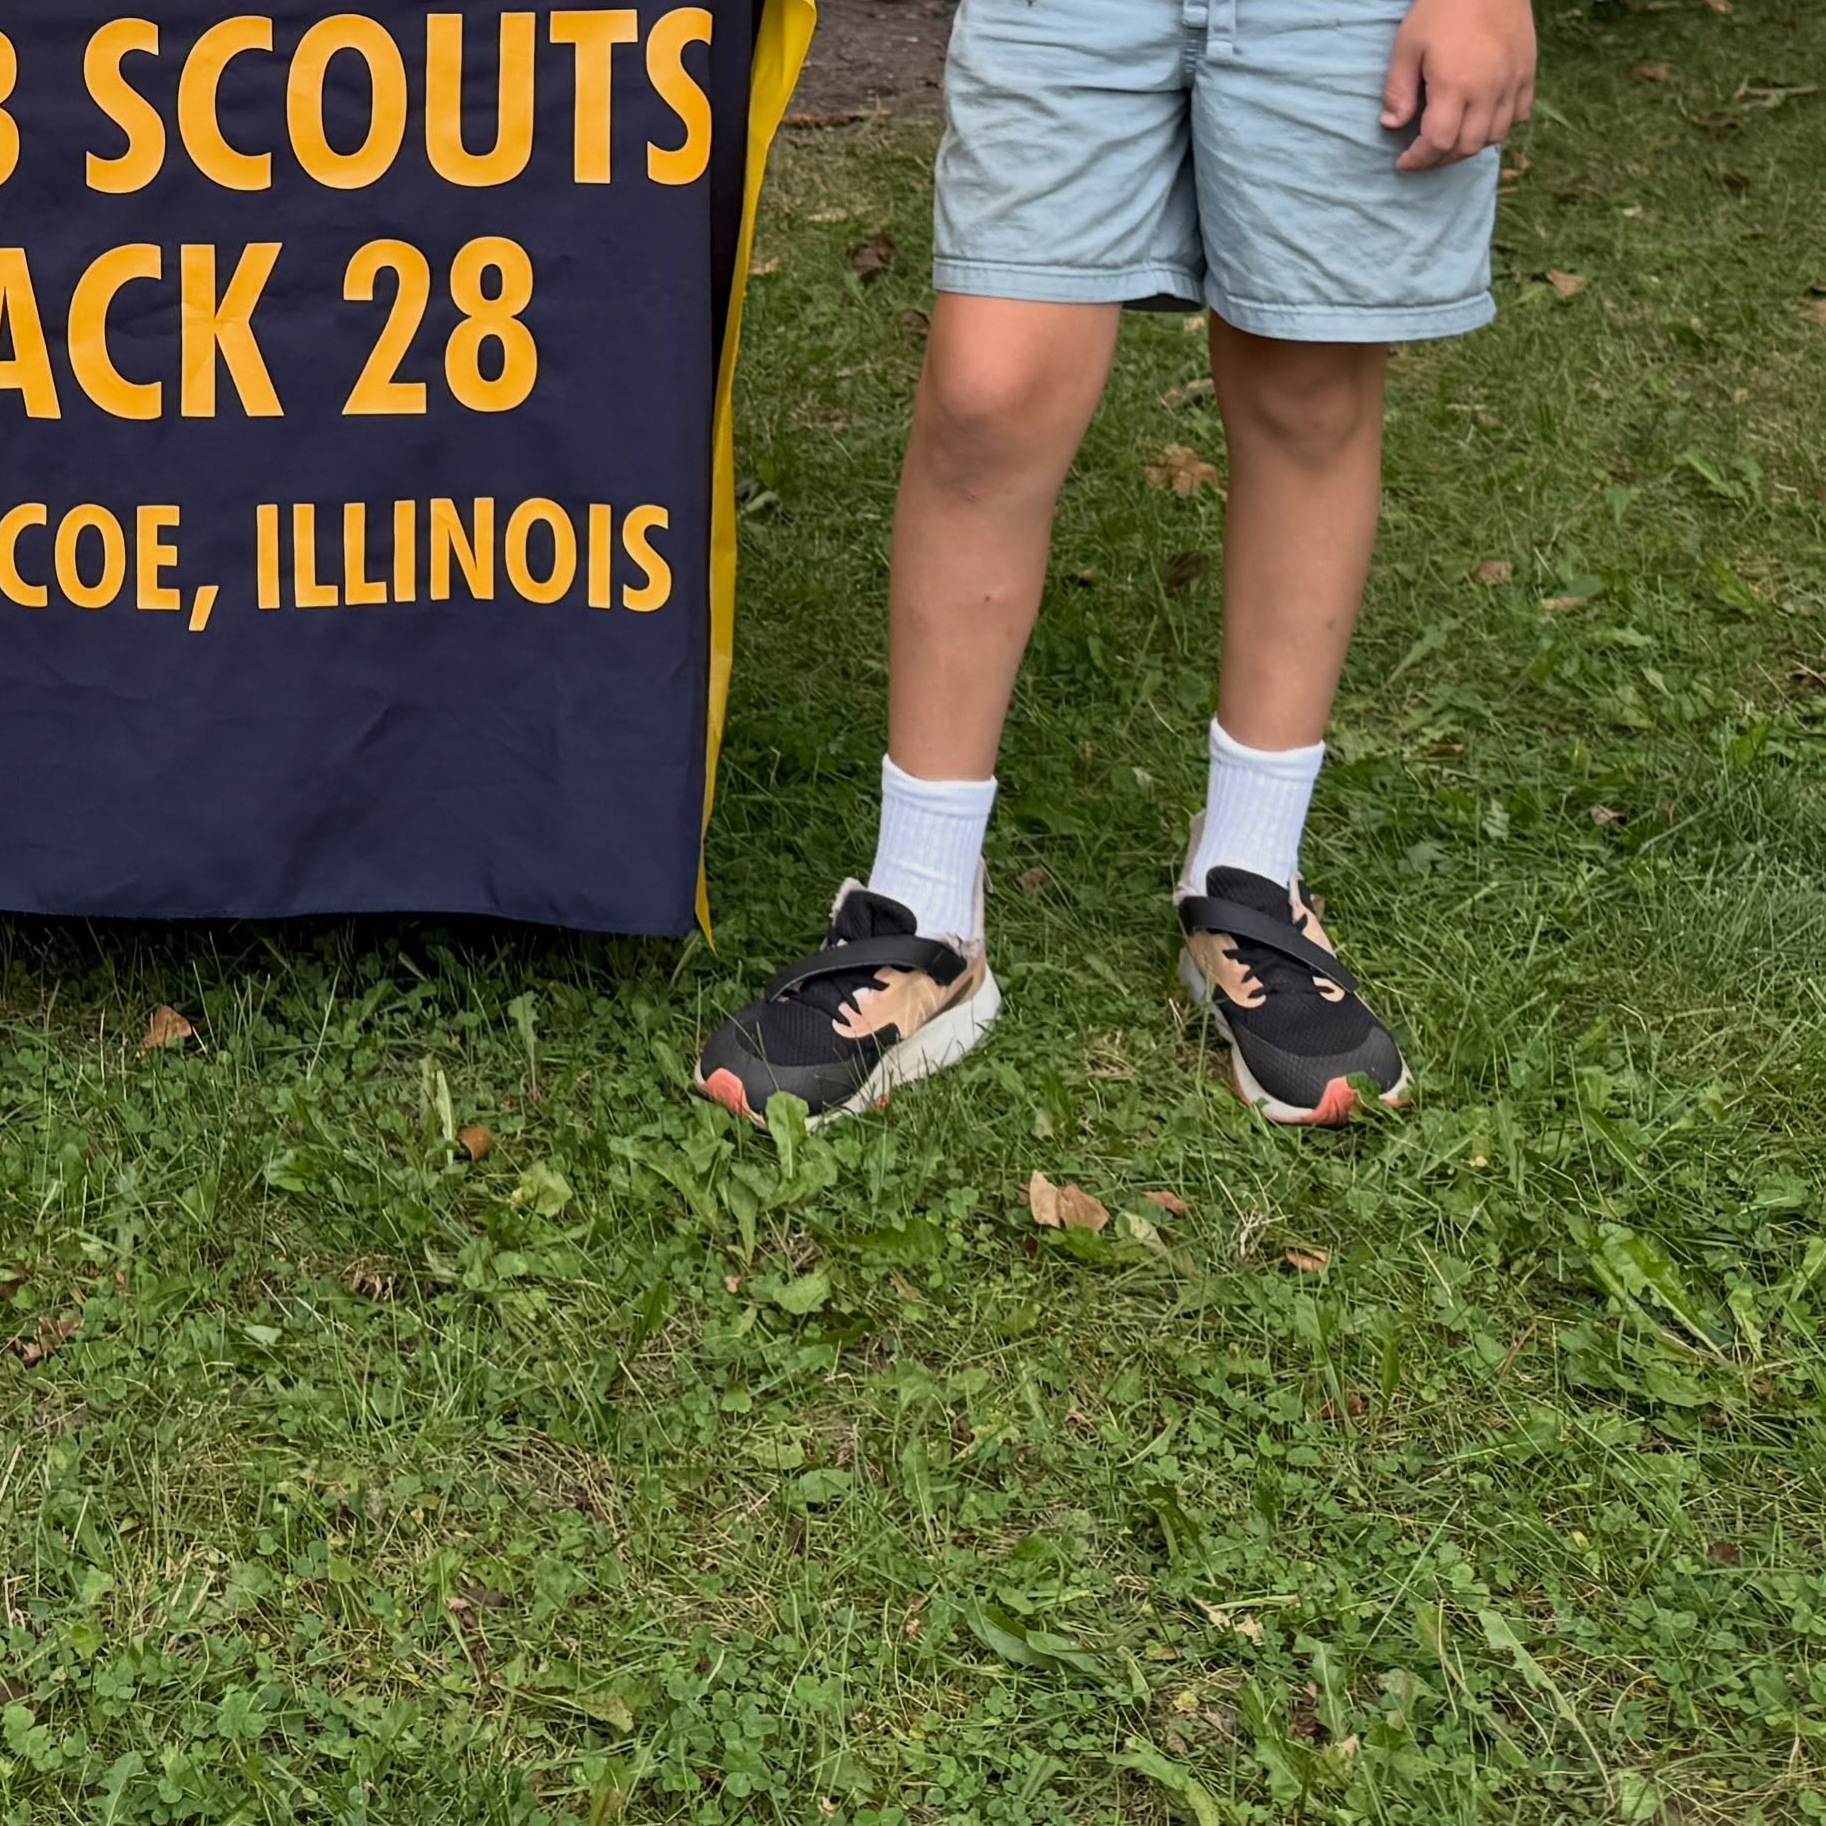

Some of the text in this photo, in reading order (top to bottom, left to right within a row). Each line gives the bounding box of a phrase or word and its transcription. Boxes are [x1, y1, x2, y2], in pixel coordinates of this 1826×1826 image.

[83, 7, 714, 193] SCOUTS
[341, 235, 538, 416] 28
[256, 496, 672, 612] ILLINOIS
